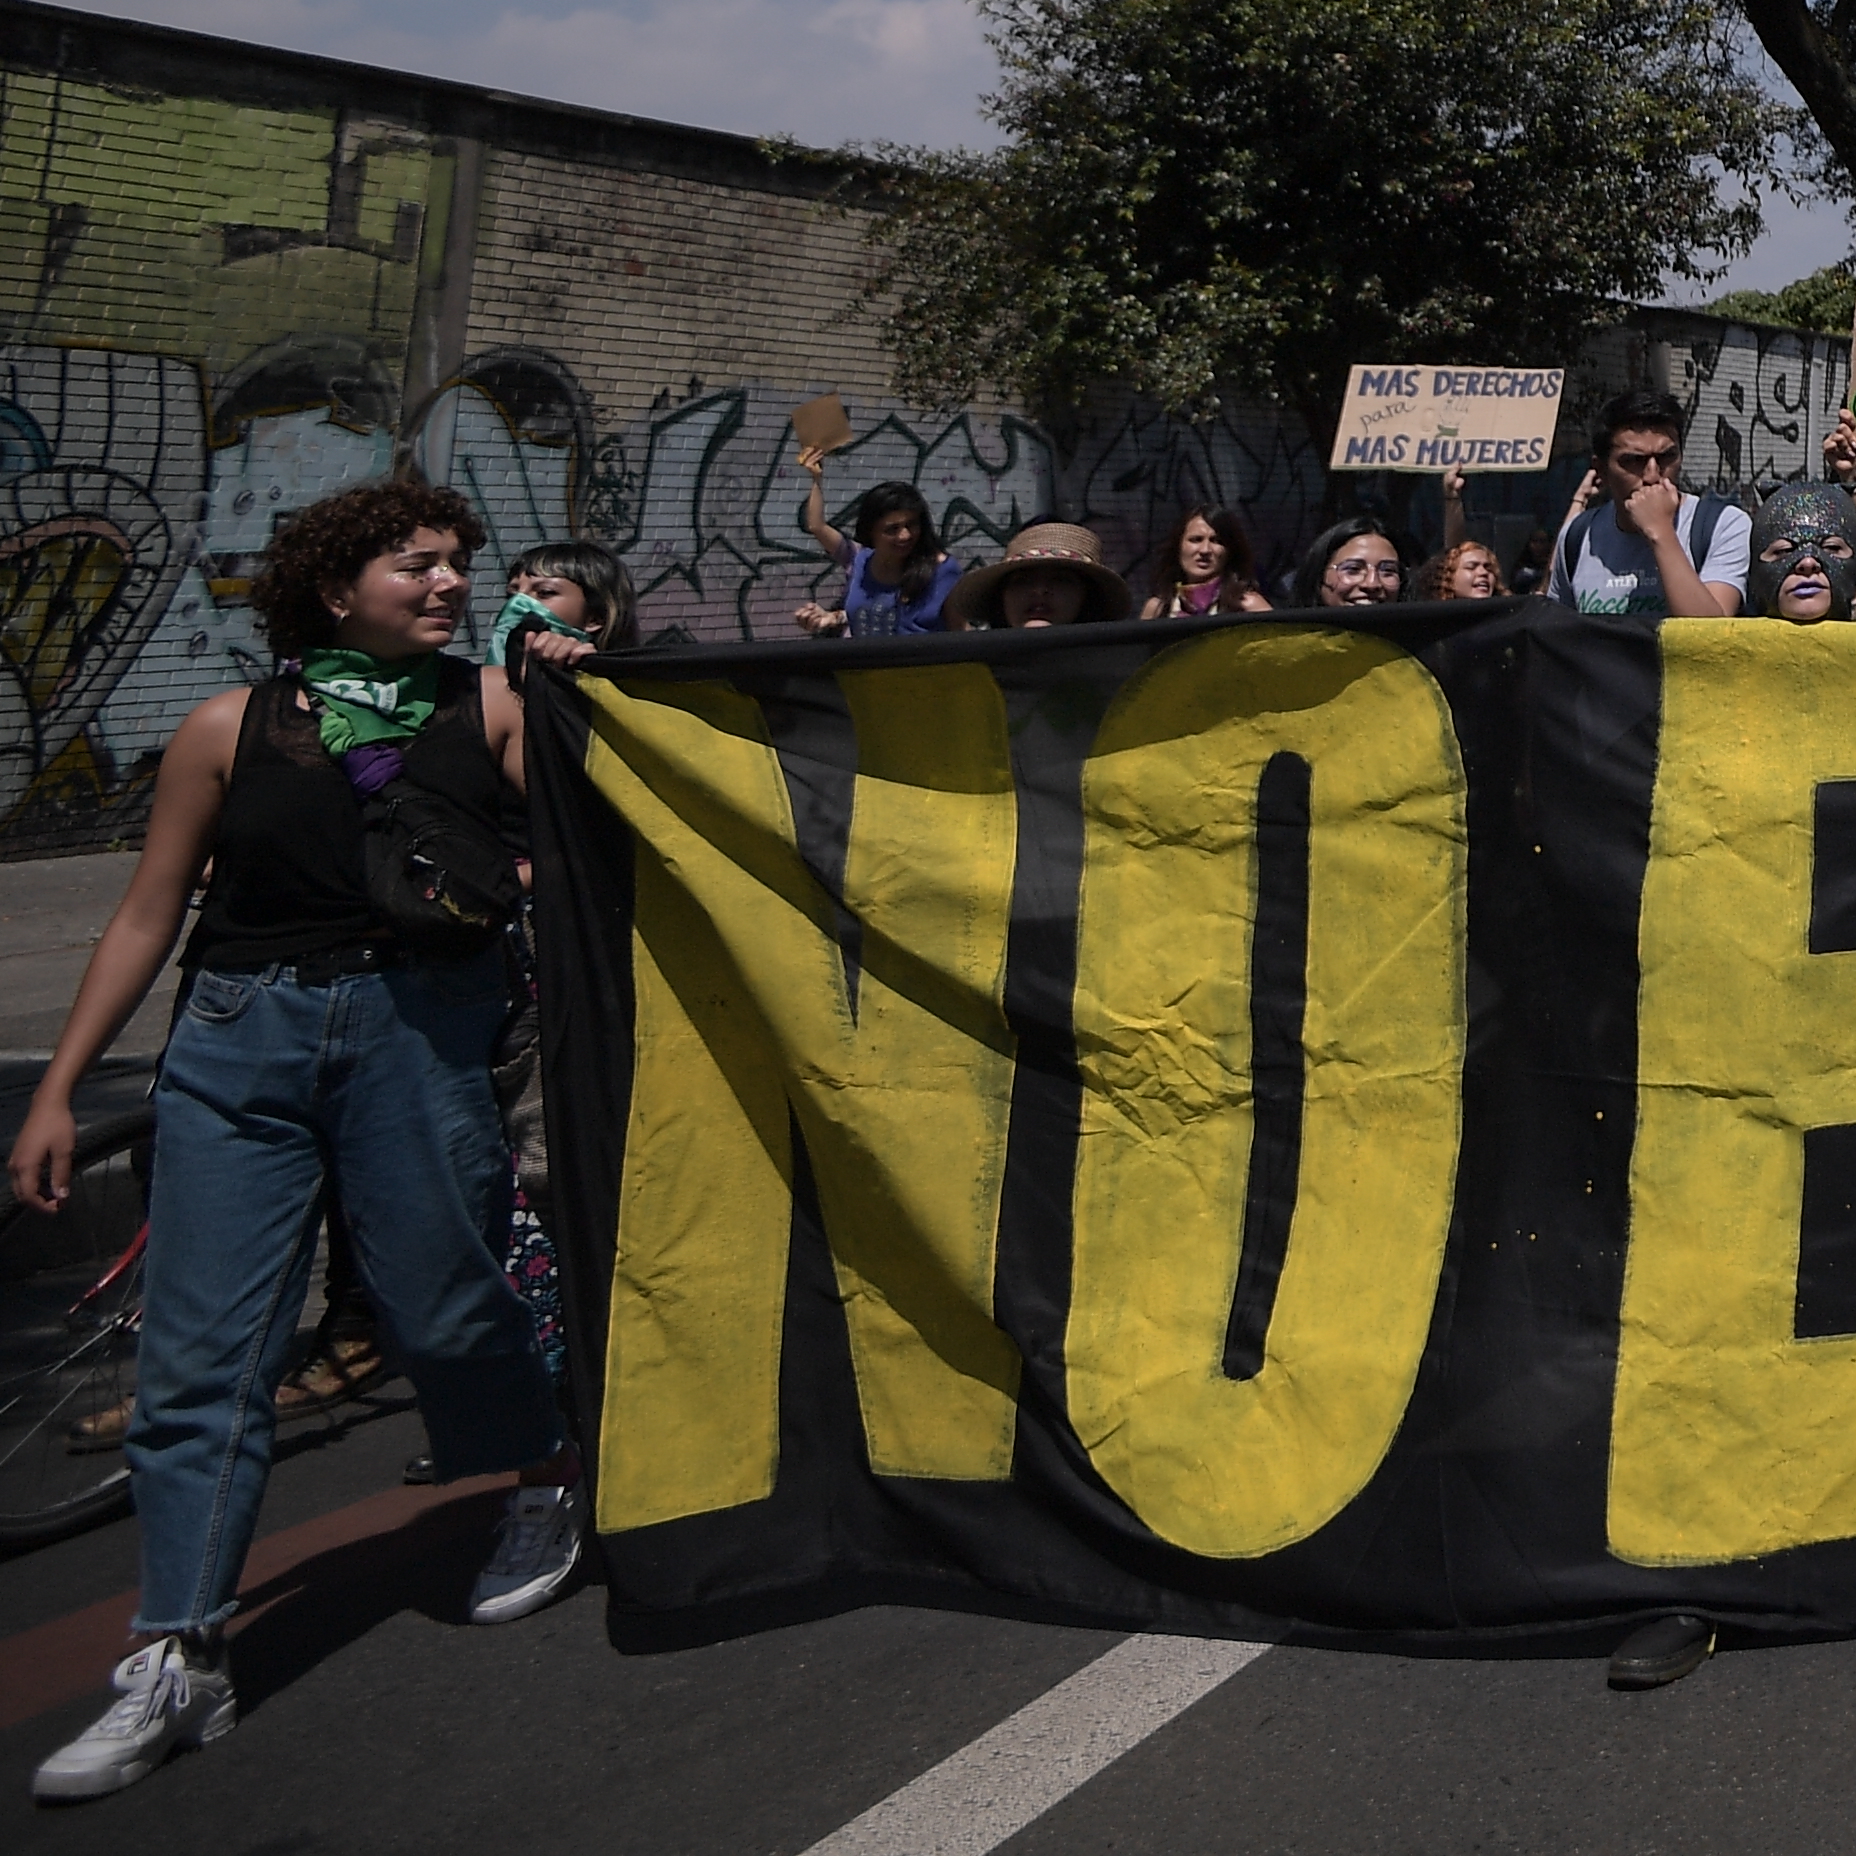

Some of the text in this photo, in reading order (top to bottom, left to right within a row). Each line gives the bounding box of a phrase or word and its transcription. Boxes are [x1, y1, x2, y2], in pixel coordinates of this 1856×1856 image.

[1359, 369, 1562, 398] MAS DERECHOS
[1359, 401, 1416, 434] para
[1344, 434, 1546, 466] MAS MUJERES
[577, 623, 1469, 1559] NO
